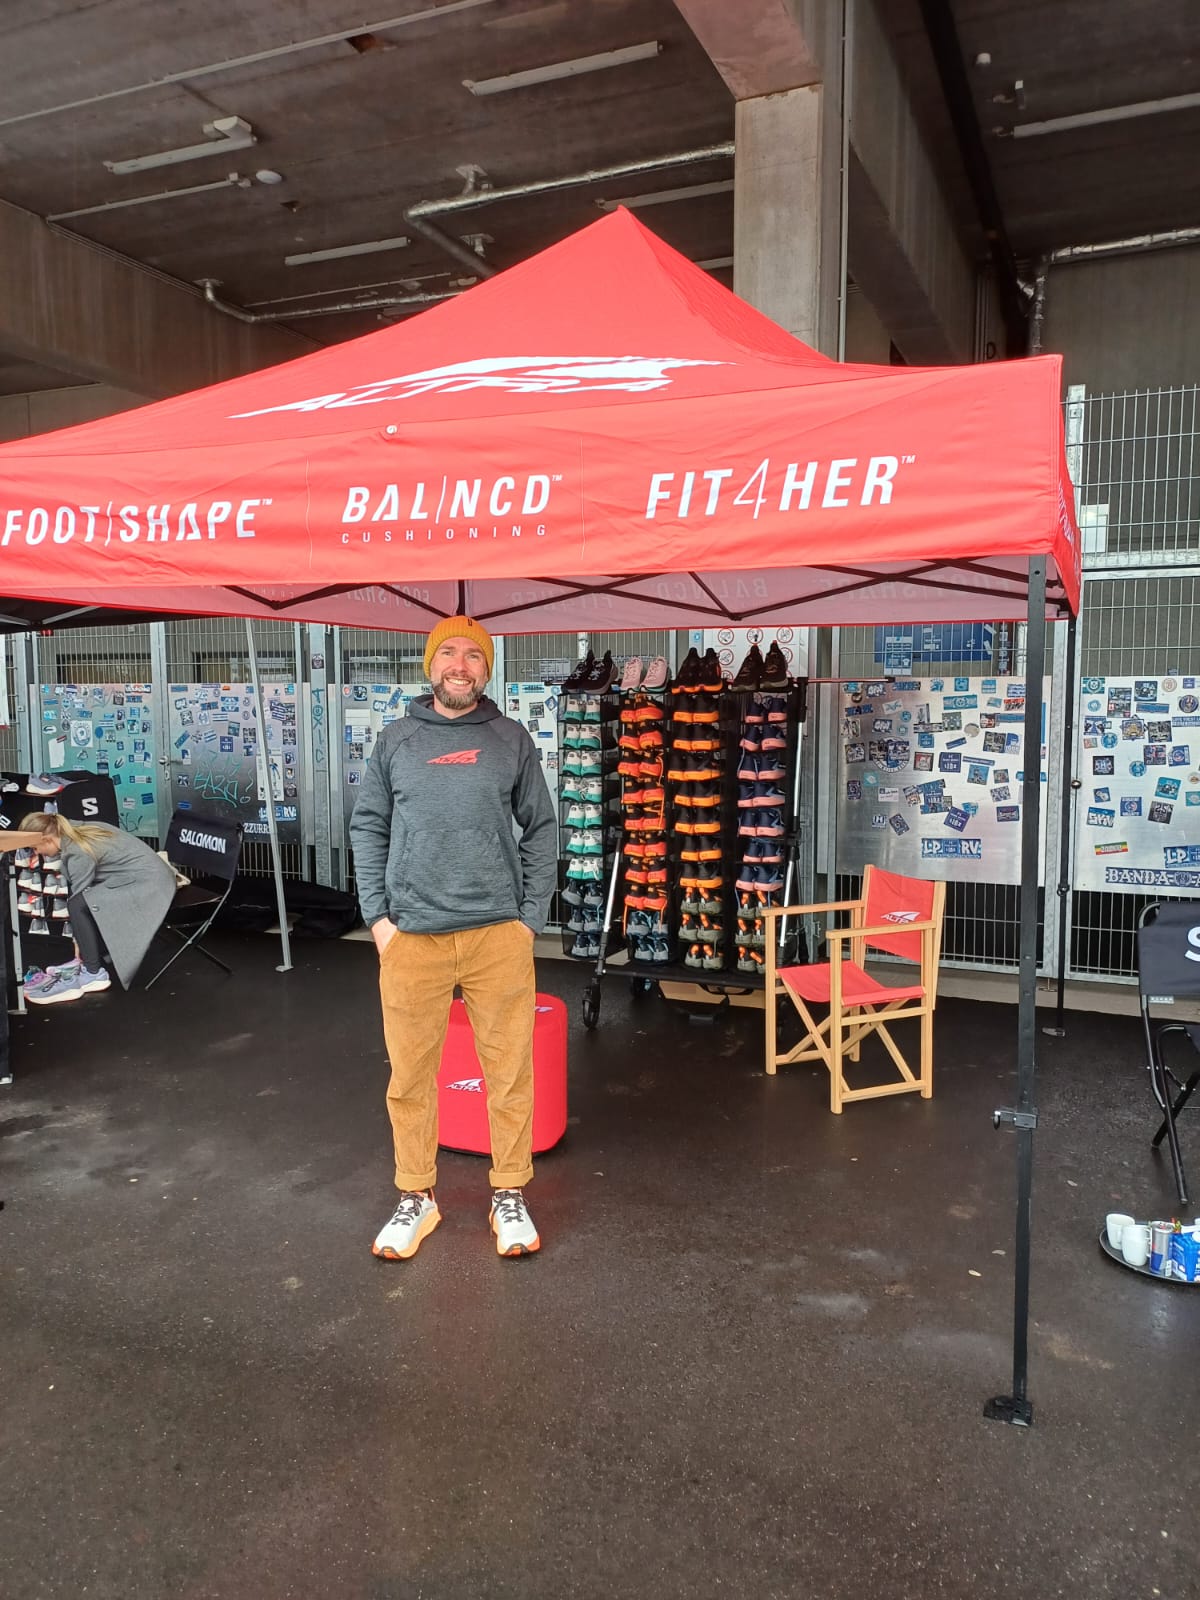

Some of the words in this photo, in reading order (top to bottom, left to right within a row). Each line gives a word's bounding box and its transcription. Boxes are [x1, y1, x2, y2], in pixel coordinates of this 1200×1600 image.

[341, 524, 547, 544] CUSHIONING
[81, 797, 99, 816] S
[179, 828, 227, 854] SALOMON
[1107, 868, 1171, 886] BANDA
